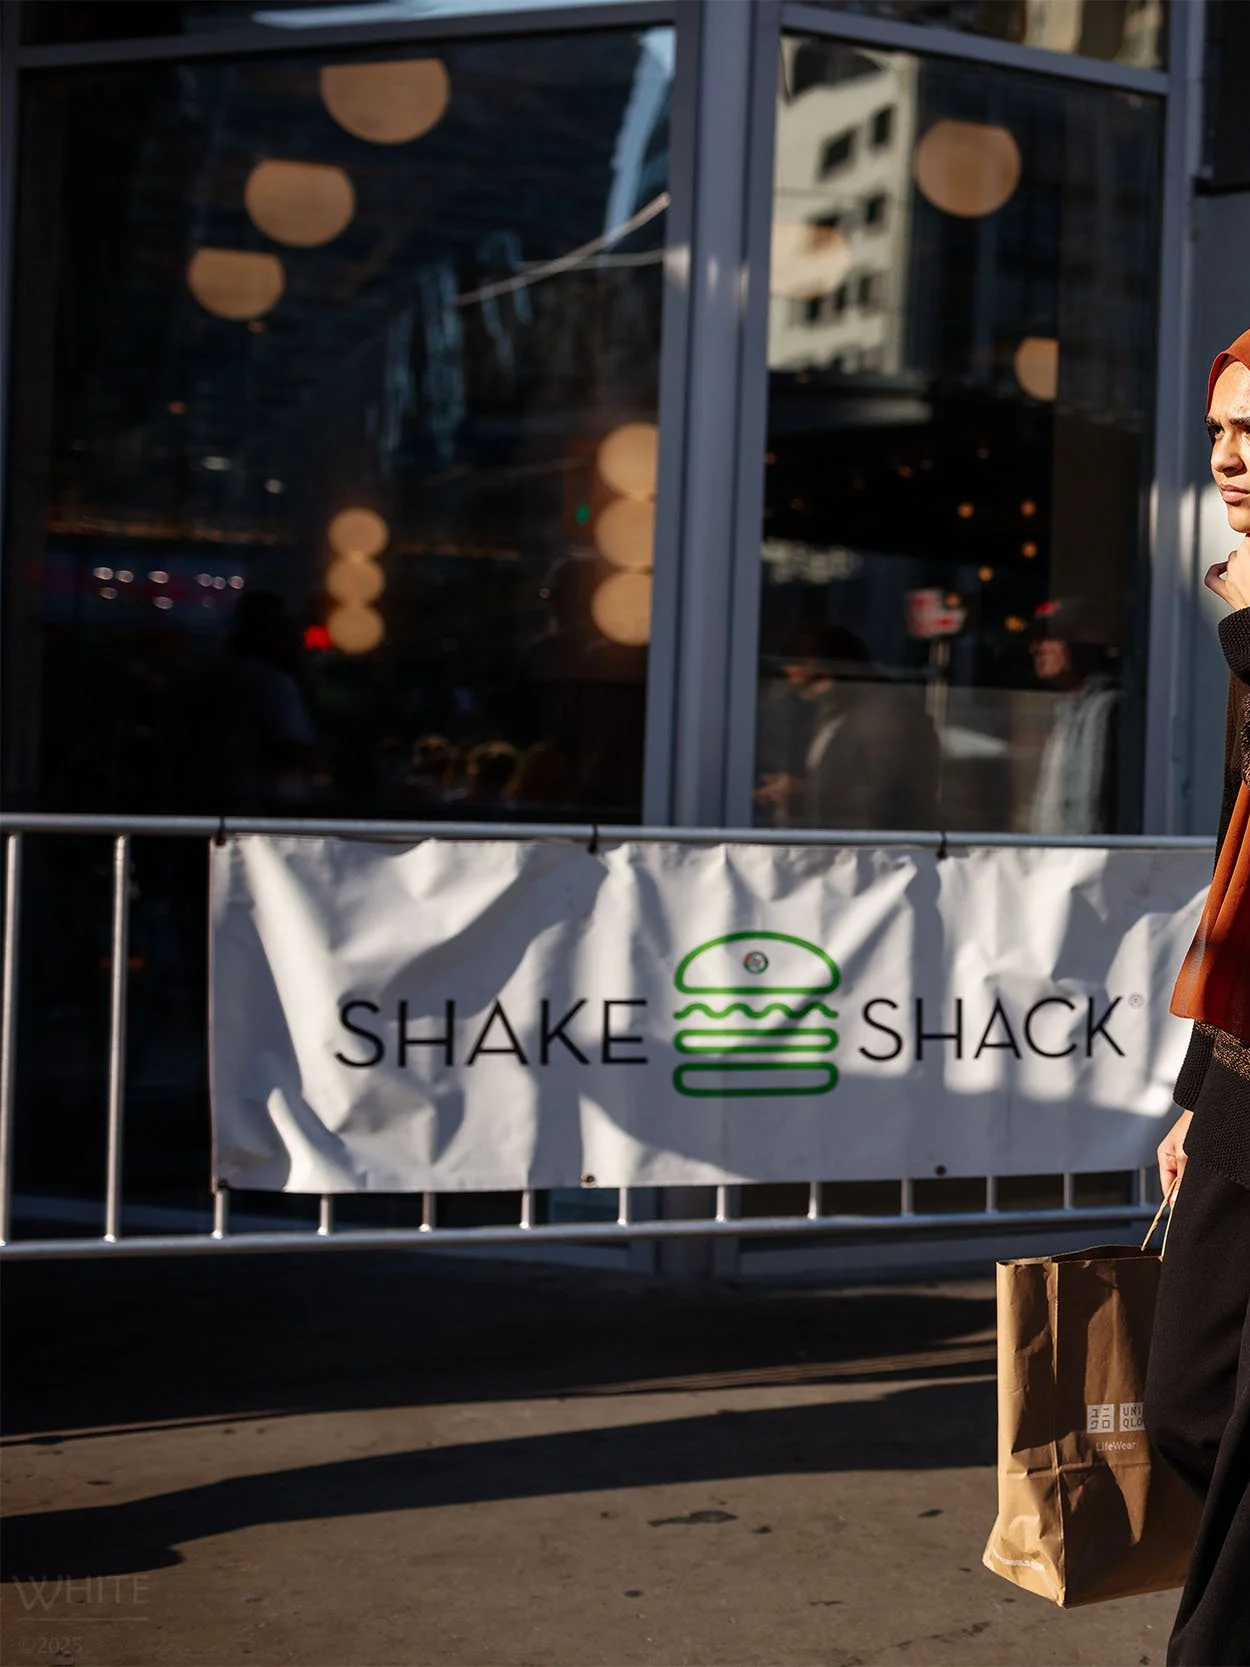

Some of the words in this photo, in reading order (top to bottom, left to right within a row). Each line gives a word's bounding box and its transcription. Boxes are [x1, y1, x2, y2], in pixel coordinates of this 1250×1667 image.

[333, 997, 650, 1069] SHAKE
[1122, 1417, 1143, 1429] QLO
[1095, 1440, 1137, 1452] LifeWear
